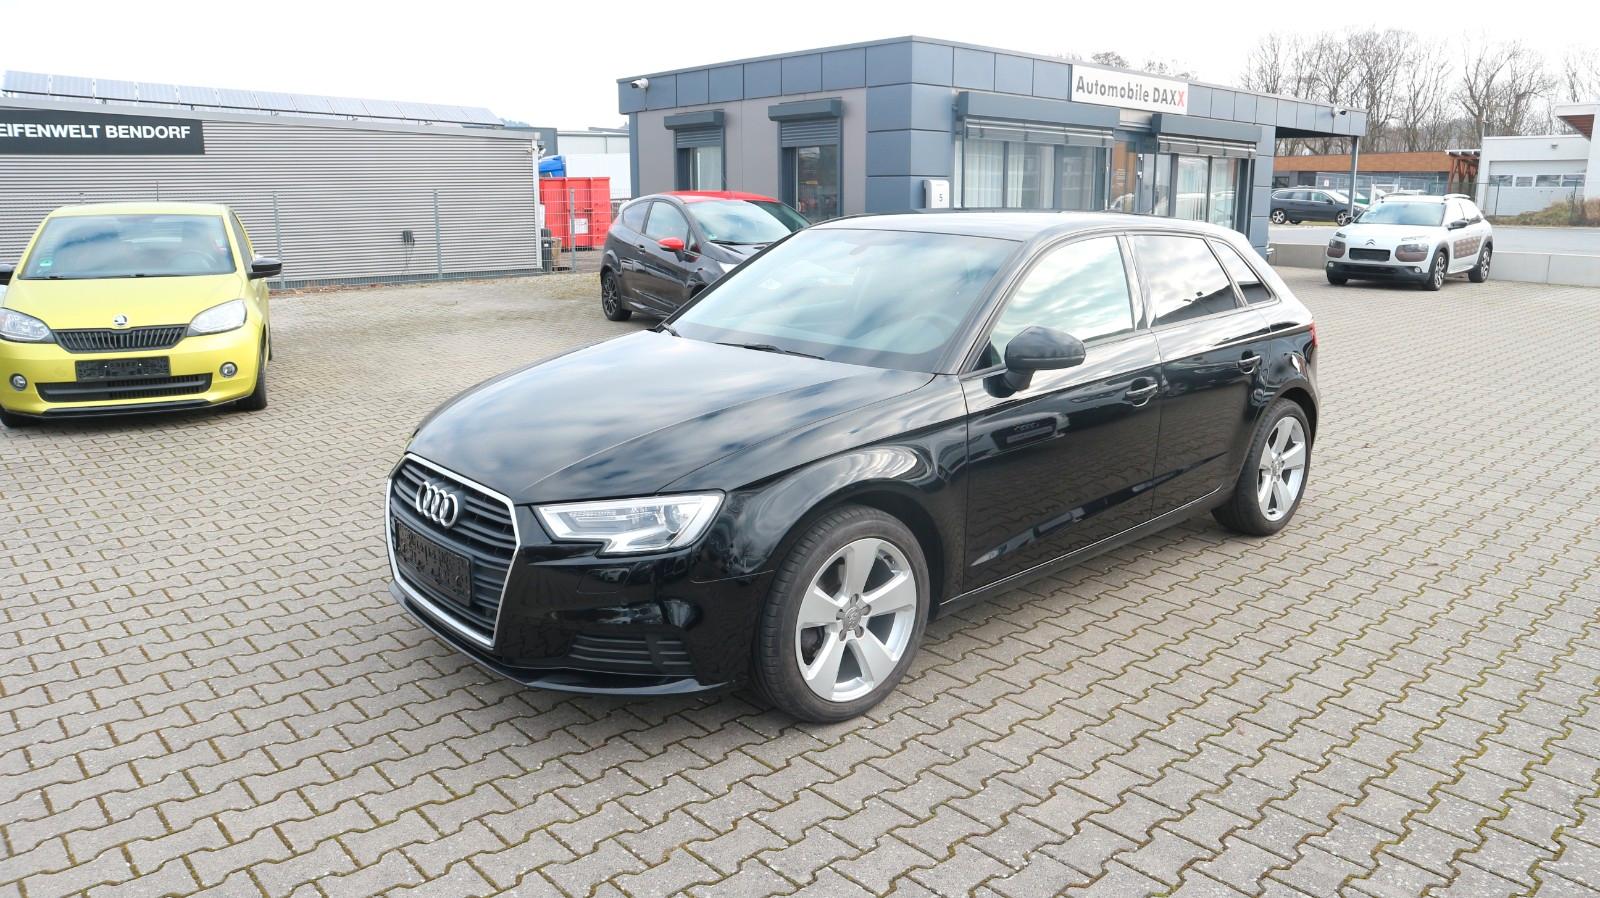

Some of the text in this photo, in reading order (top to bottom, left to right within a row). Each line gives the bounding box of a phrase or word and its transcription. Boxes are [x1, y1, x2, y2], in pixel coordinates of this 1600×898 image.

[1076, 76, 1184, 107] Automobile DAXX
[0, 123, 191, 139] EIFENWELT BENDORF
[938, 193, 944, 202] 5
